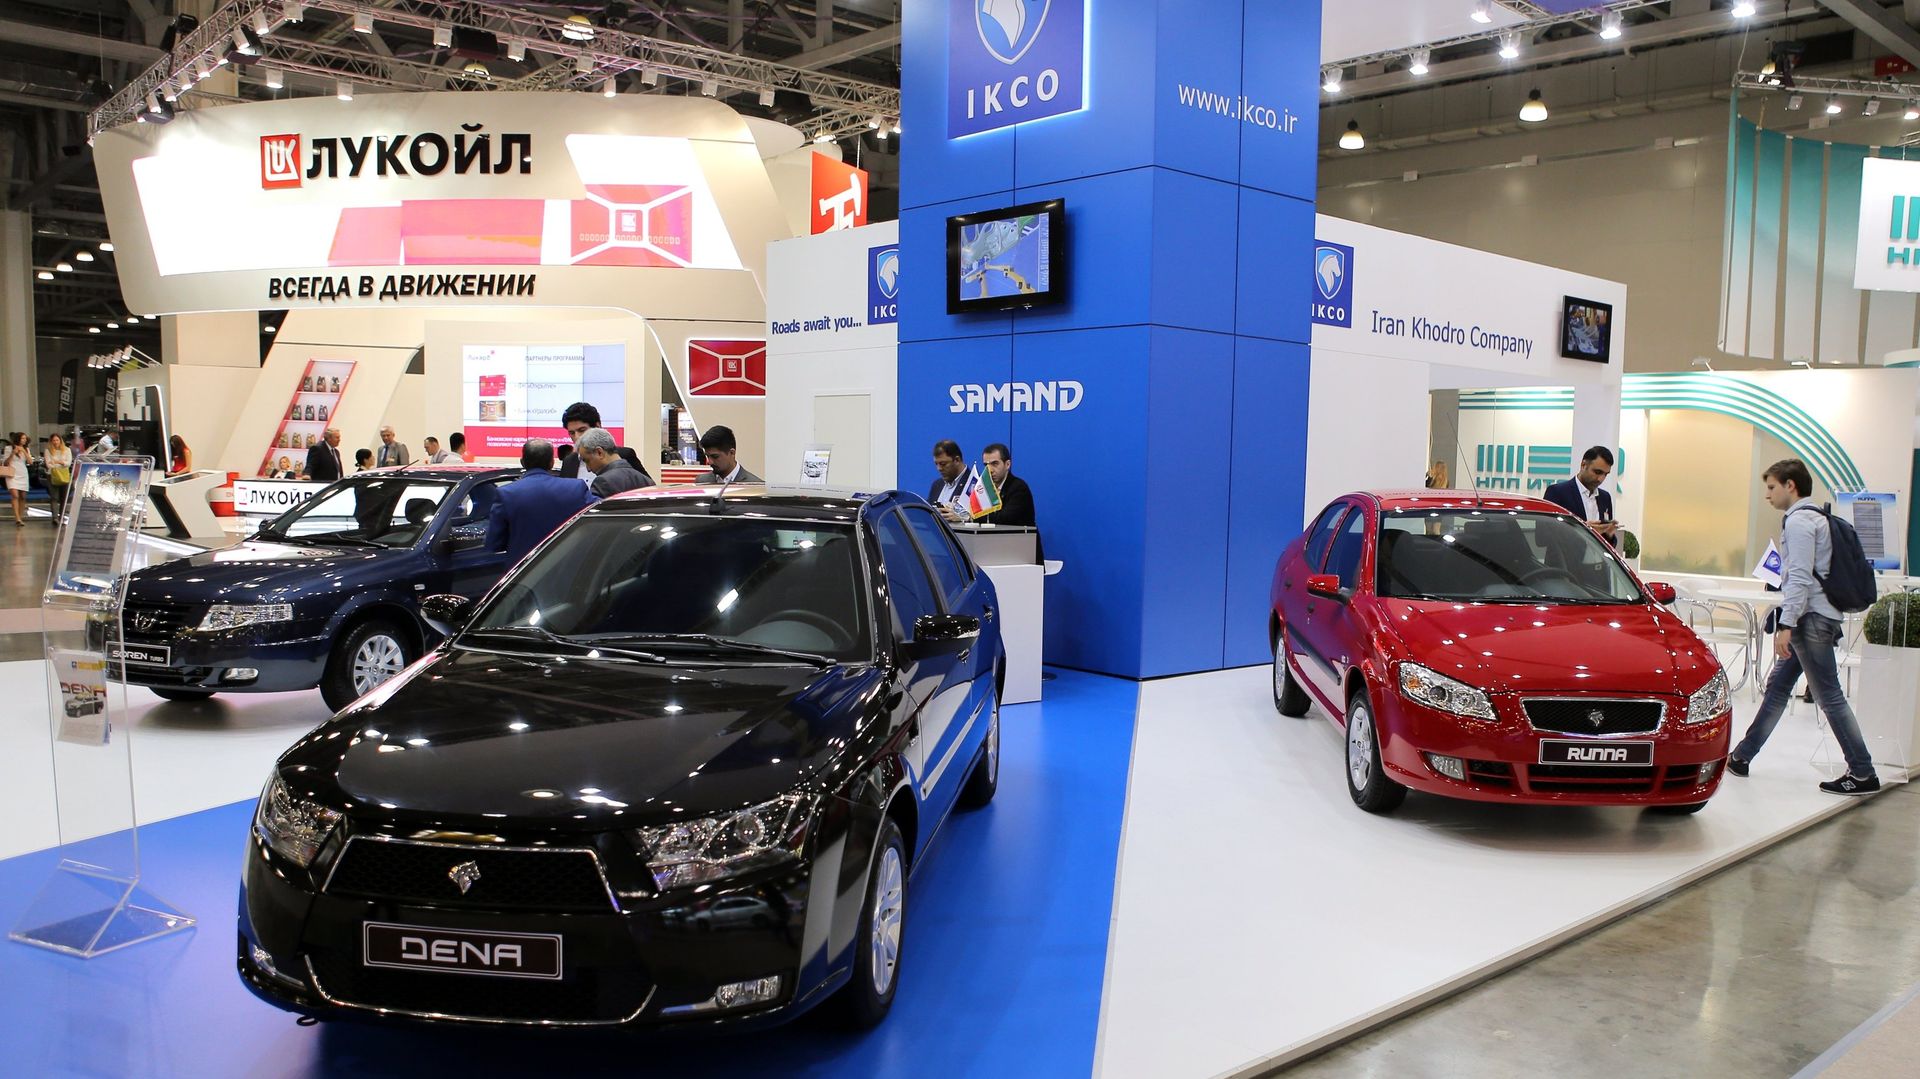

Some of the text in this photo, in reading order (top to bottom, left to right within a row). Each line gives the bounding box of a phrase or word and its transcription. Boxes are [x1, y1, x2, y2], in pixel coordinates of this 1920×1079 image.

[967, 69, 1060, 120] IKCO
[1178, 83, 1298, 134] www.ikco.ir
[306, 123, 532, 178] ЛУКОЙЛ
[269, 274, 536, 302] ВСЕГДА В ДВИЖЕНИИ
[772, 316, 862, 335] Roads await you...
[874, 304, 897, 319] IKC
[1311, 303, 1346, 321] IKCO
[1371, 310, 1533, 359] Iran Khodro Company
[60, 376, 71, 412] TIBUS
[104, 377, 116, 413] TIBUS
[950, 380, 1084, 413] SAMAND
[1476, 477, 1520, 490] НПП
[112, 650, 148, 660] SOREN
[1567, 747, 1628, 761] RUNNA
[401, 936, 522, 967] DENA
